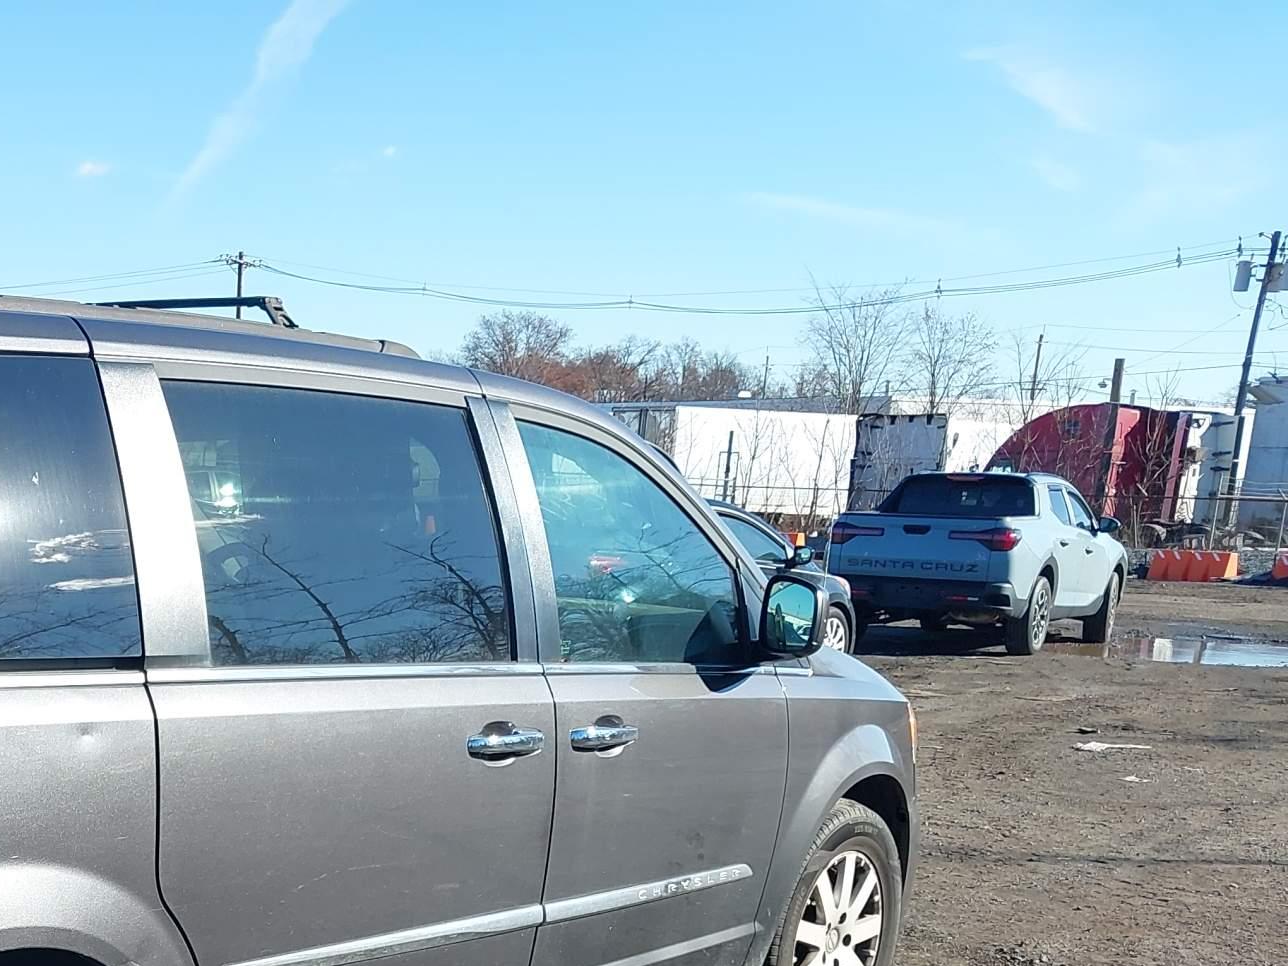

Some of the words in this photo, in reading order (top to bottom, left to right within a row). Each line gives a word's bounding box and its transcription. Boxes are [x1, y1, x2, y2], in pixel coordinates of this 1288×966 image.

[847, 557, 915, 570] SANTA
[920, 561, 979, 574] CRUZ
[637, 867, 743, 900] CHRYSLER
